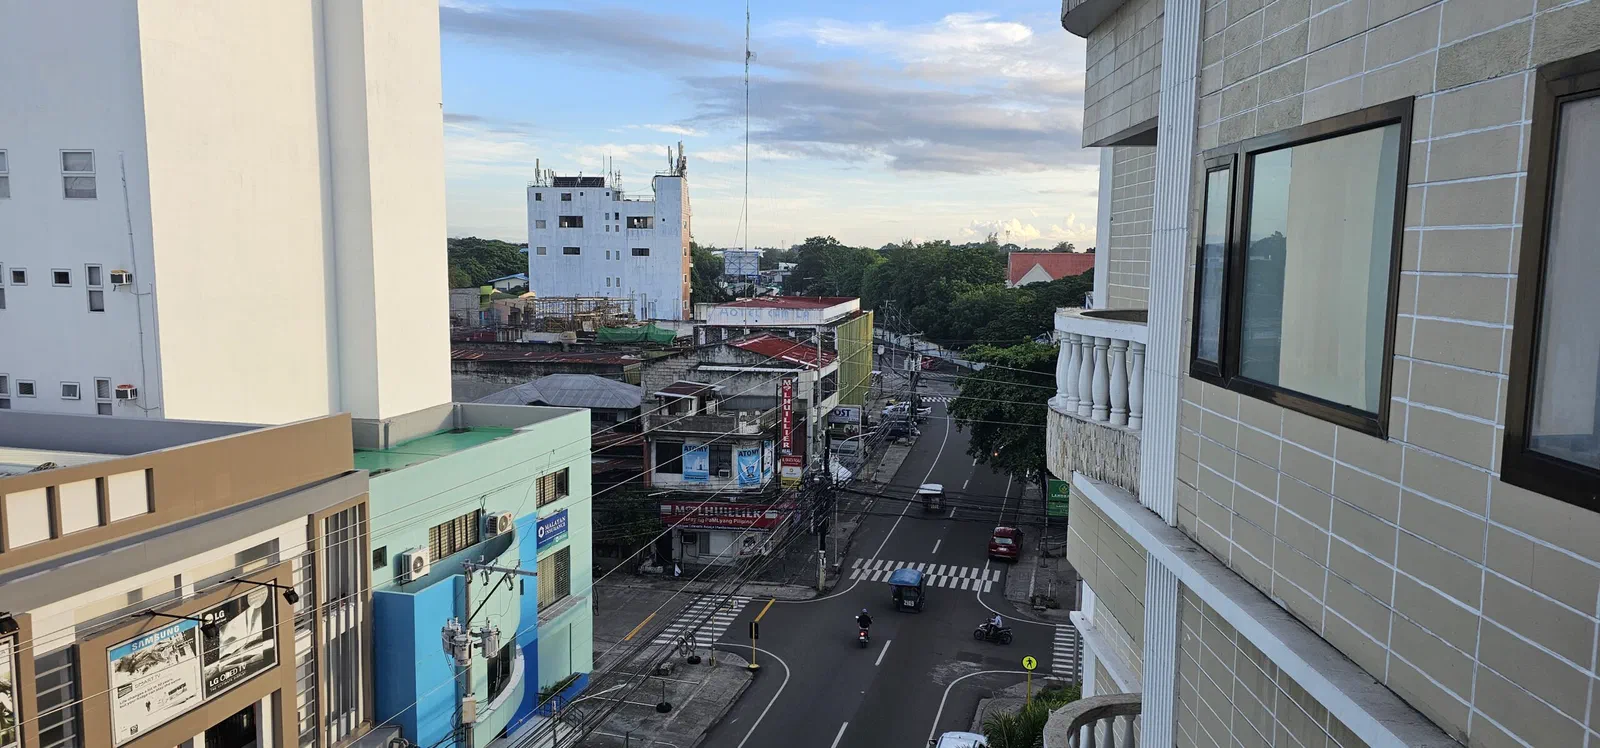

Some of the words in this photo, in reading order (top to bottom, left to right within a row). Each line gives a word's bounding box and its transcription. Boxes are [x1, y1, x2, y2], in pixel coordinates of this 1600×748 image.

[720, 308, 760, 318] HOTEL
[684, 445, 708, 453] ATOMY
[738, 448, 760, 457] ATOMY
[545, 515, 566, 530] MALAYAN
[545, 522, 566, 535] INSURANCE
[214, 610, 225, 621] LG
[131, 625, 180, 651] SAMSUNG
[209, 677, 219, 687] LG
